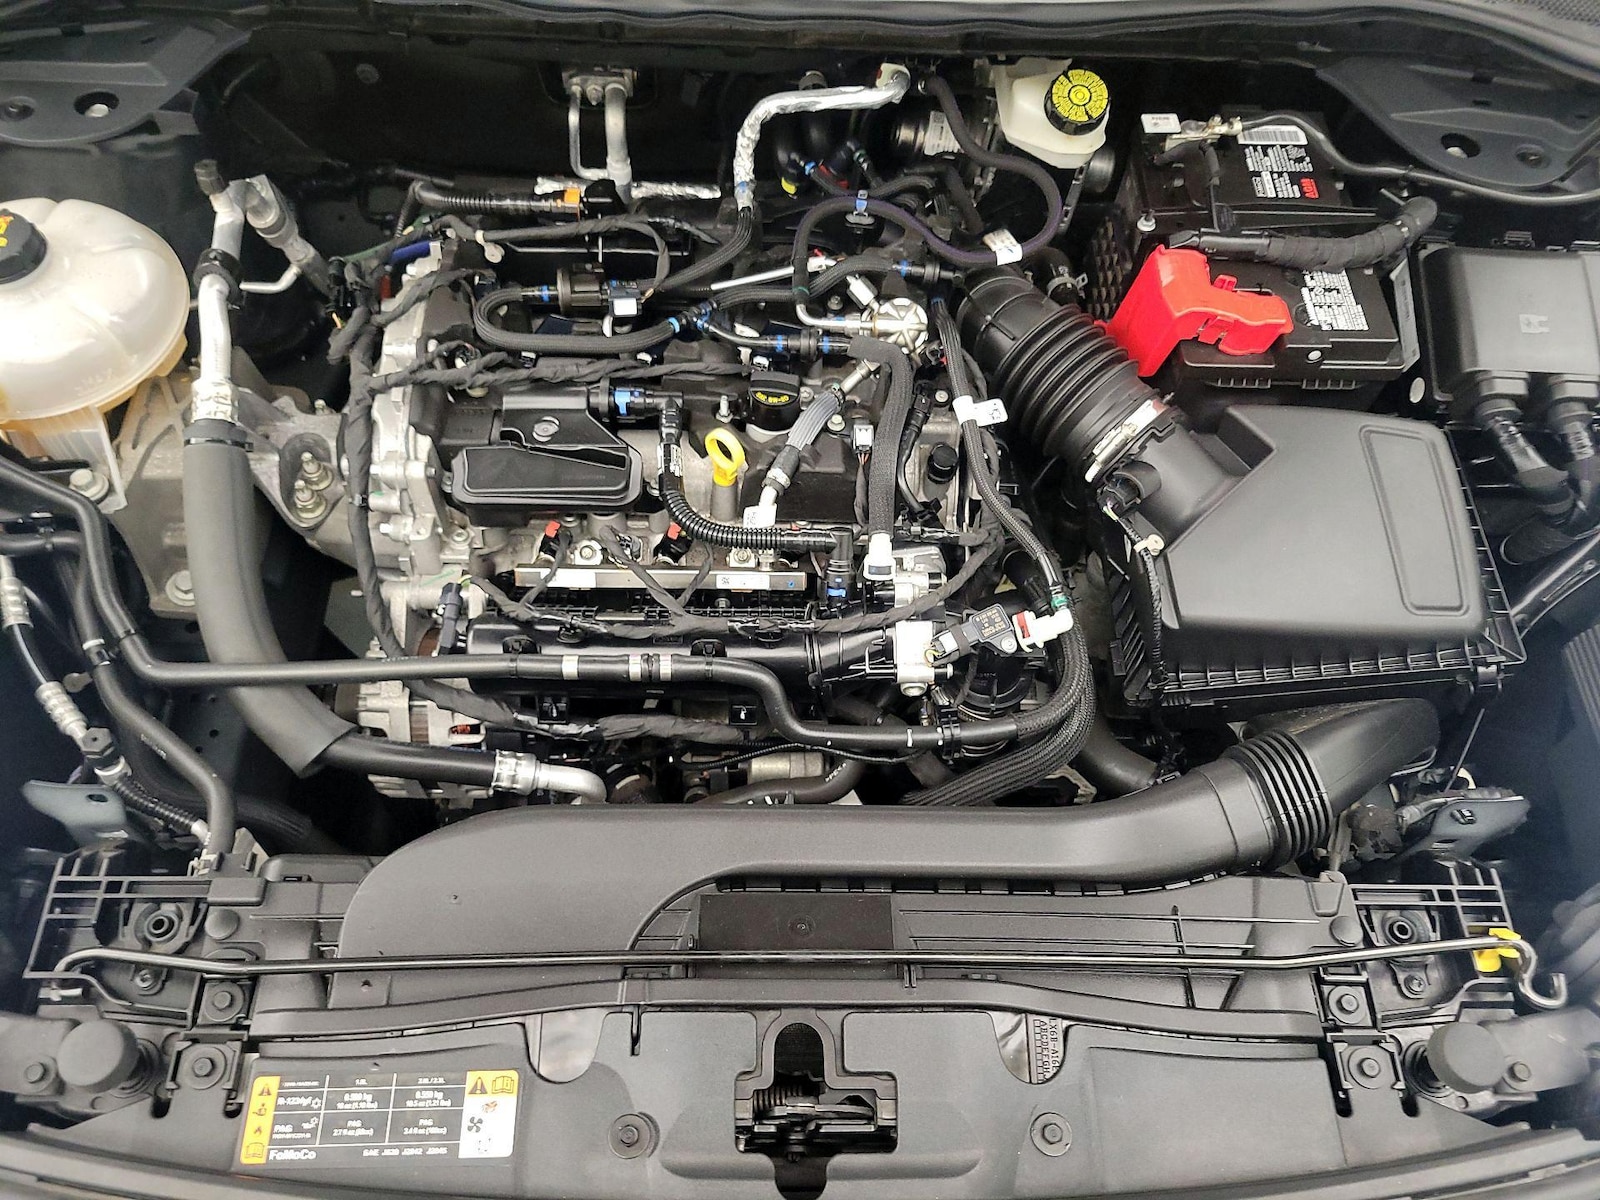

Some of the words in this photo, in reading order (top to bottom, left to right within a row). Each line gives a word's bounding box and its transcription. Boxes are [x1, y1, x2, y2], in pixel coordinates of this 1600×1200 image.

[1301, 178, 1319, 198] AGM
[273, 1124, 293, 1133] PAG
[347, 1120, 362, 1128] PAG
[268, 1148, 317, 1161] FoMoCo
